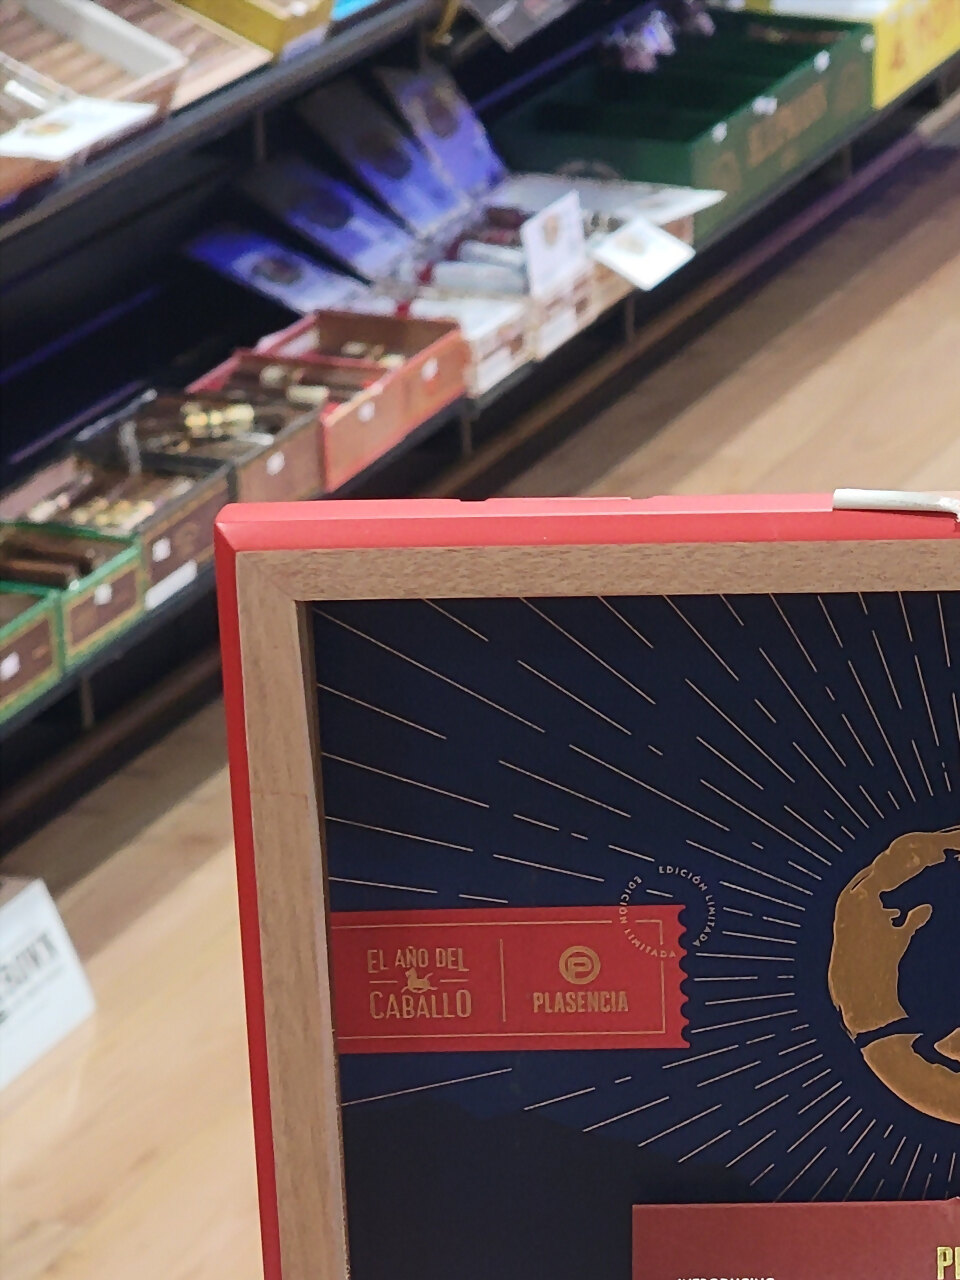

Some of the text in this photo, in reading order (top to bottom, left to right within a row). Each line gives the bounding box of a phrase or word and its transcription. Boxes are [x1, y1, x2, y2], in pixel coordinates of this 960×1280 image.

[658, 866, 716, 947] EDICIÓN LIMITADA
[367, 946, 470, 973] EL AÑO DEL
[369, 989, 472, 1019] CABALLO
[533, 990, 629, 1013] PLASENCIA
